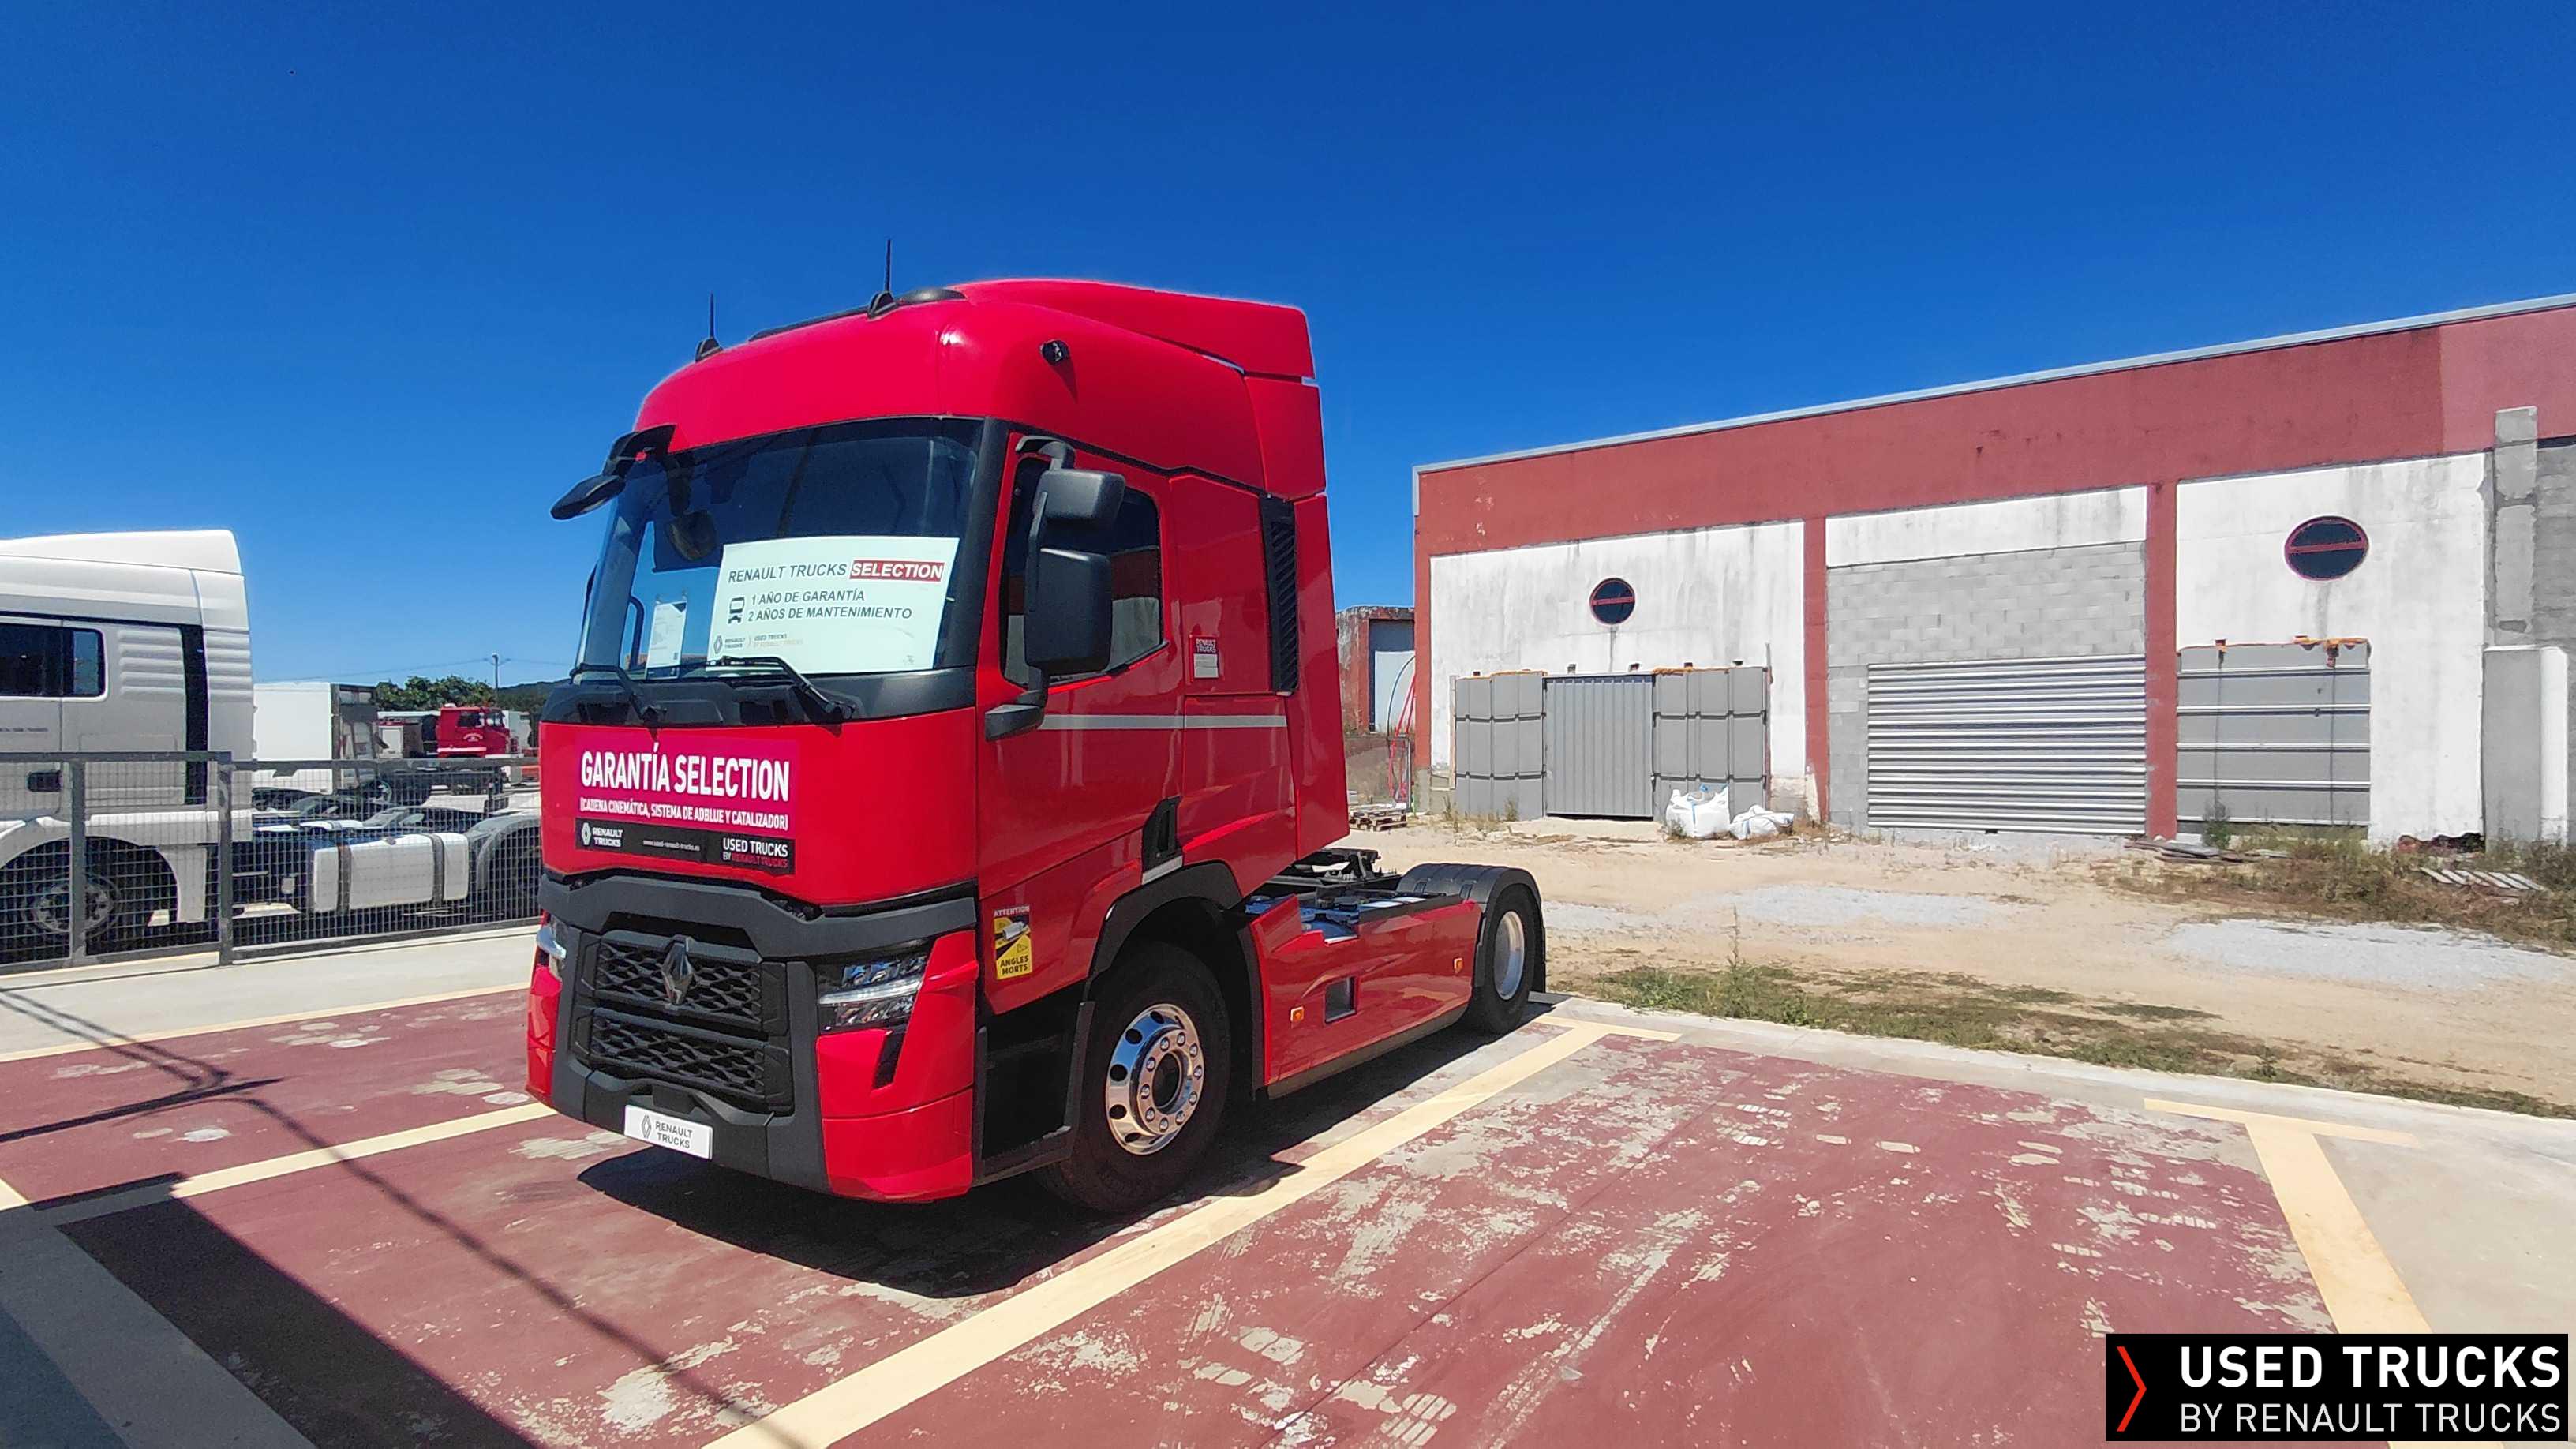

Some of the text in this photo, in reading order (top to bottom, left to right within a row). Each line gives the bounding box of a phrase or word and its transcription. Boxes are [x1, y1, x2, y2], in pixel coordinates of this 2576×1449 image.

[728, 562, 944, 583] RENAULT TRUCKS SELECTION
[751, 588, 865, 605] 1 AÑO DE GARANTÍA
[748, 606, 912, 621] 2 AÑOS DE MANTENIMIENTO
[581, 742, 789, 802] GARANTÍA SELECTION
[651, 803, 682, 818] SISTEMA
[683, 806, 693, 820] DE
[694, 807, 724, 823] ADBLUE
[725, 810, 732, 824] Y
[593, 827, 623, 837] RENAULT
[593, 837, 621, 847] TRUCKS
[723, 837, 788, 857] USED TRUCKS
[722, 852, 731, 860] BY
[1000, 955, 1028, 967] ANGLES
[1002, 964, 1028, 975] MORTS
[655, 1121, 693, 1138] RENAULT
[657, 1133, 690, 1149] TRUCKS
